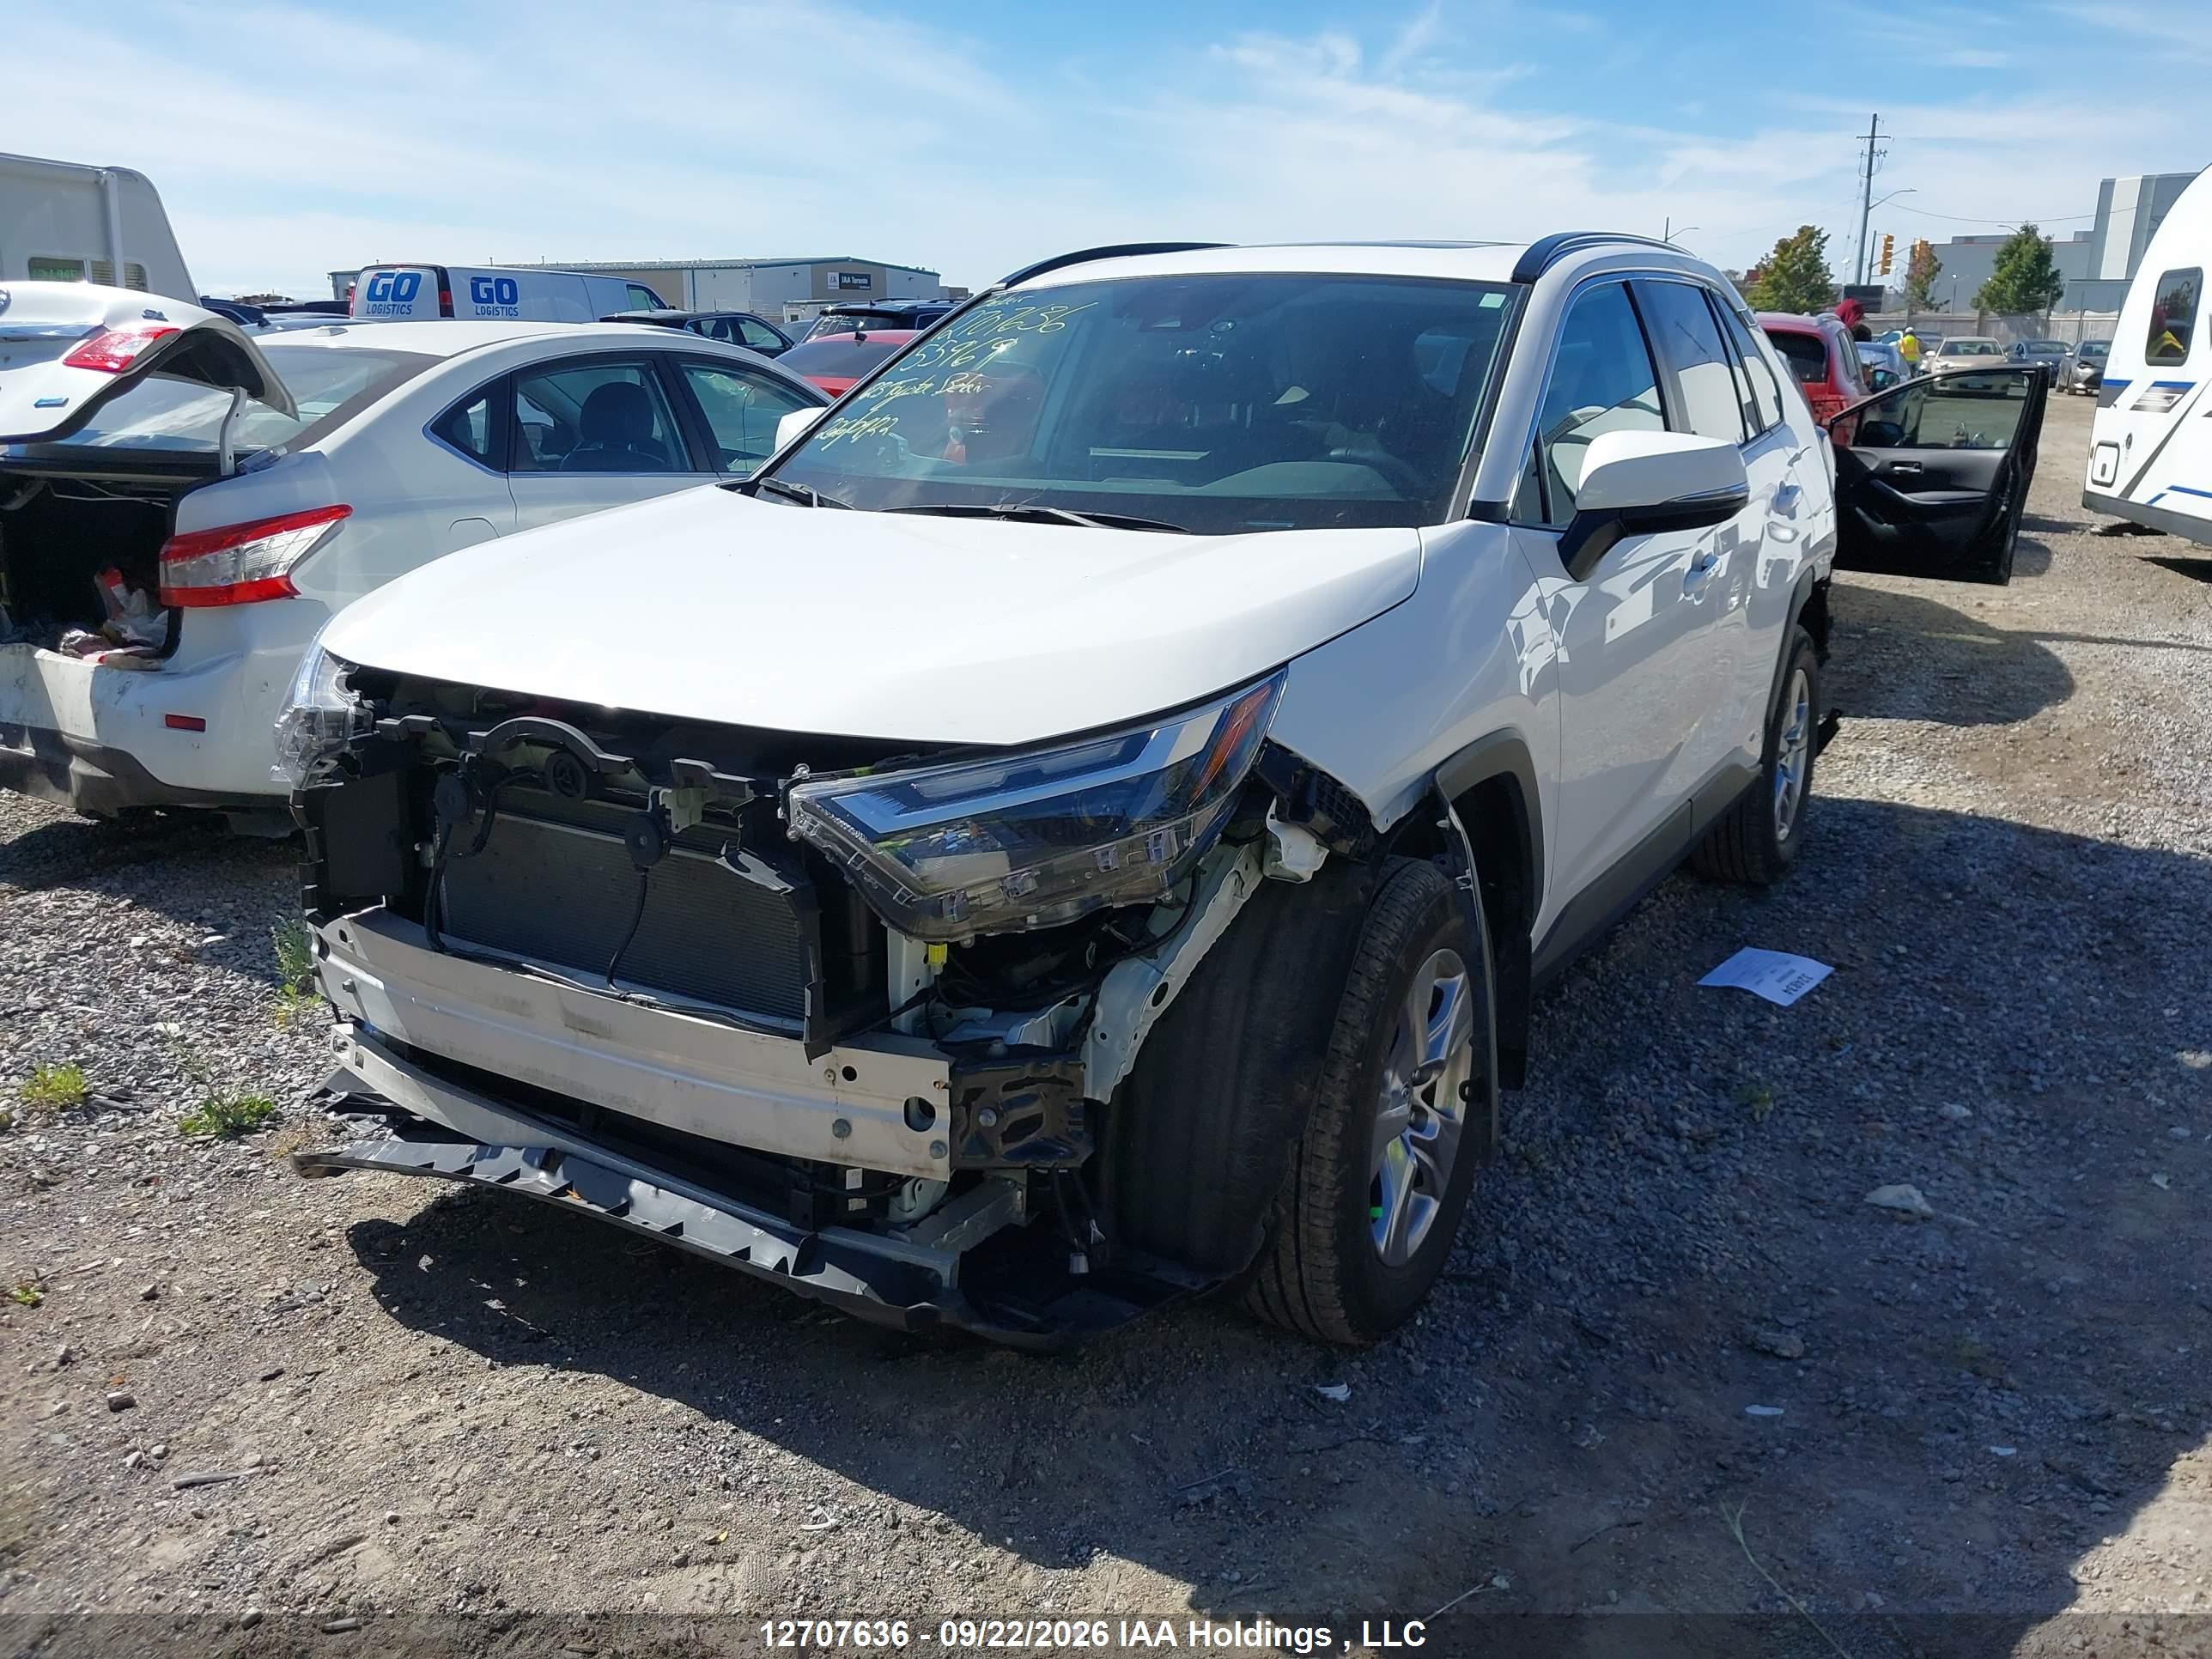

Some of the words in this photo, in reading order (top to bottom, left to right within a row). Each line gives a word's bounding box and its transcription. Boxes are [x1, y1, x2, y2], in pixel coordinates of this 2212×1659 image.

[366, 272, 422, 302] GO
[471, 276, 519, 305] GO
[366, 303, 413, 316] LOGISTICS
[474, 305, 520, 317] LOGISTICS
